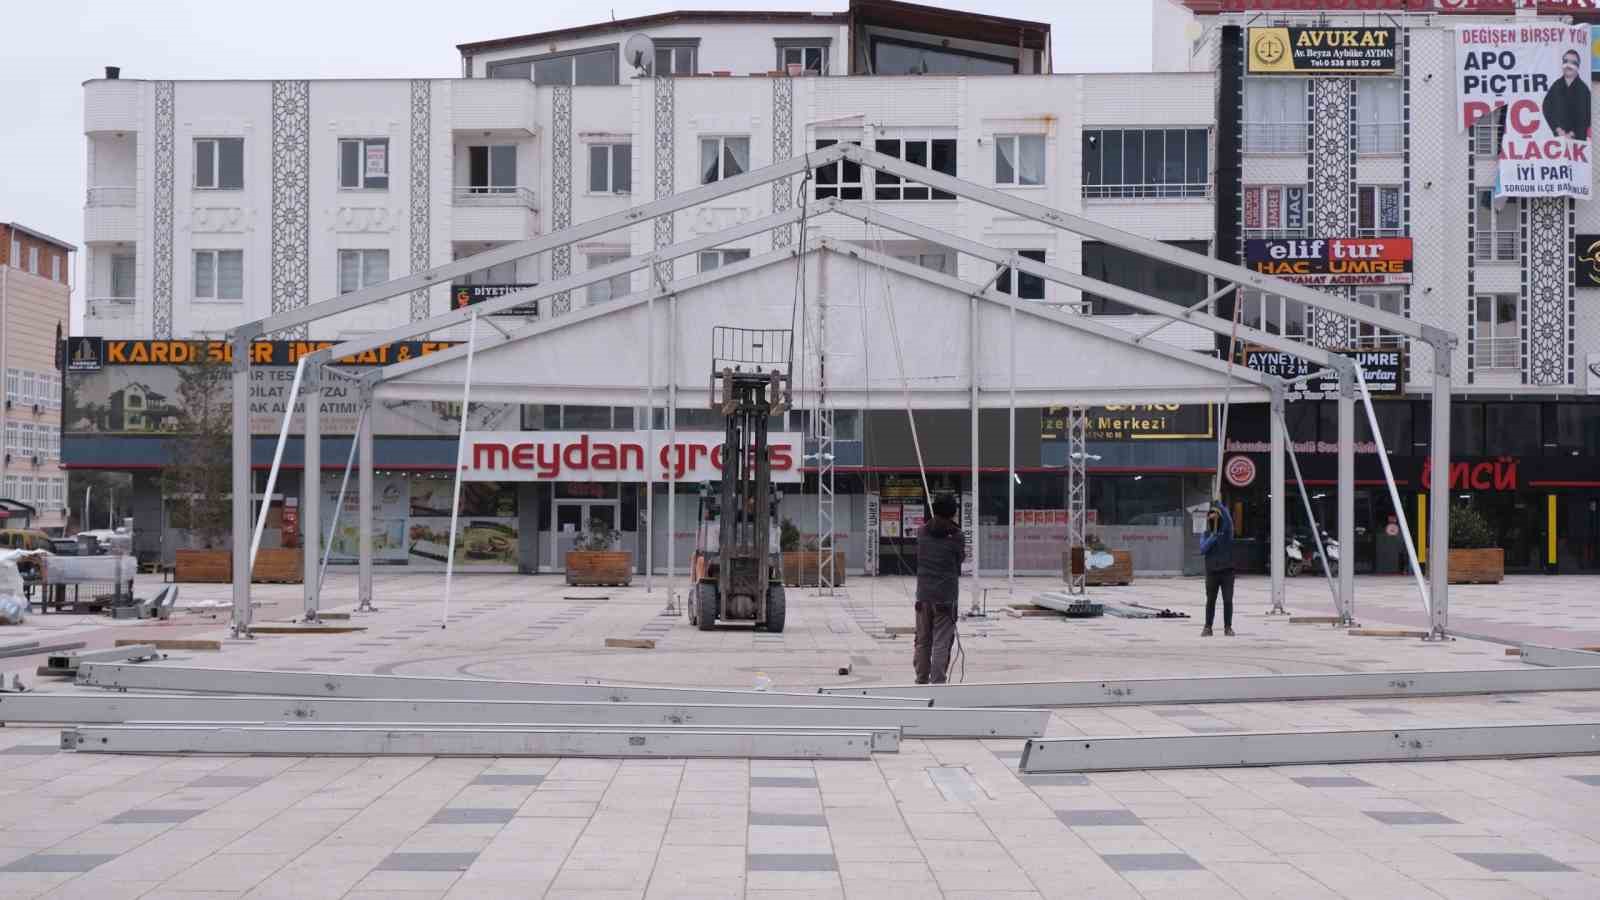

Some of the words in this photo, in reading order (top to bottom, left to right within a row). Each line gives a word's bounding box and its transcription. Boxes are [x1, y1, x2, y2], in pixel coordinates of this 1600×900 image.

[1296, 30, 1388, 47] AVUKAT
[1462, 29, 1516, 46] DEĞİŞEN
[1521, 26, 1565, 45] BİRŞEY
[1464, 51, 1516, 70] APO
[1516, 163, 1535, 180] İYİ
[1504, 184, 1535, 193] SORGUN
[1289, 190, 1301, 227] HAC
[1270, 240, 1325, 259] elif
[1333, 241, 1384, 257] tur
[1257, 261, 1311, 274] HAC
[1329, 260, 1404, 273] UMRE
[1331, 275, 1385, 284] ACENTASI
[1099, 417, 1166, 429] Merkezi
[473, 434, 645, 478] meydan
